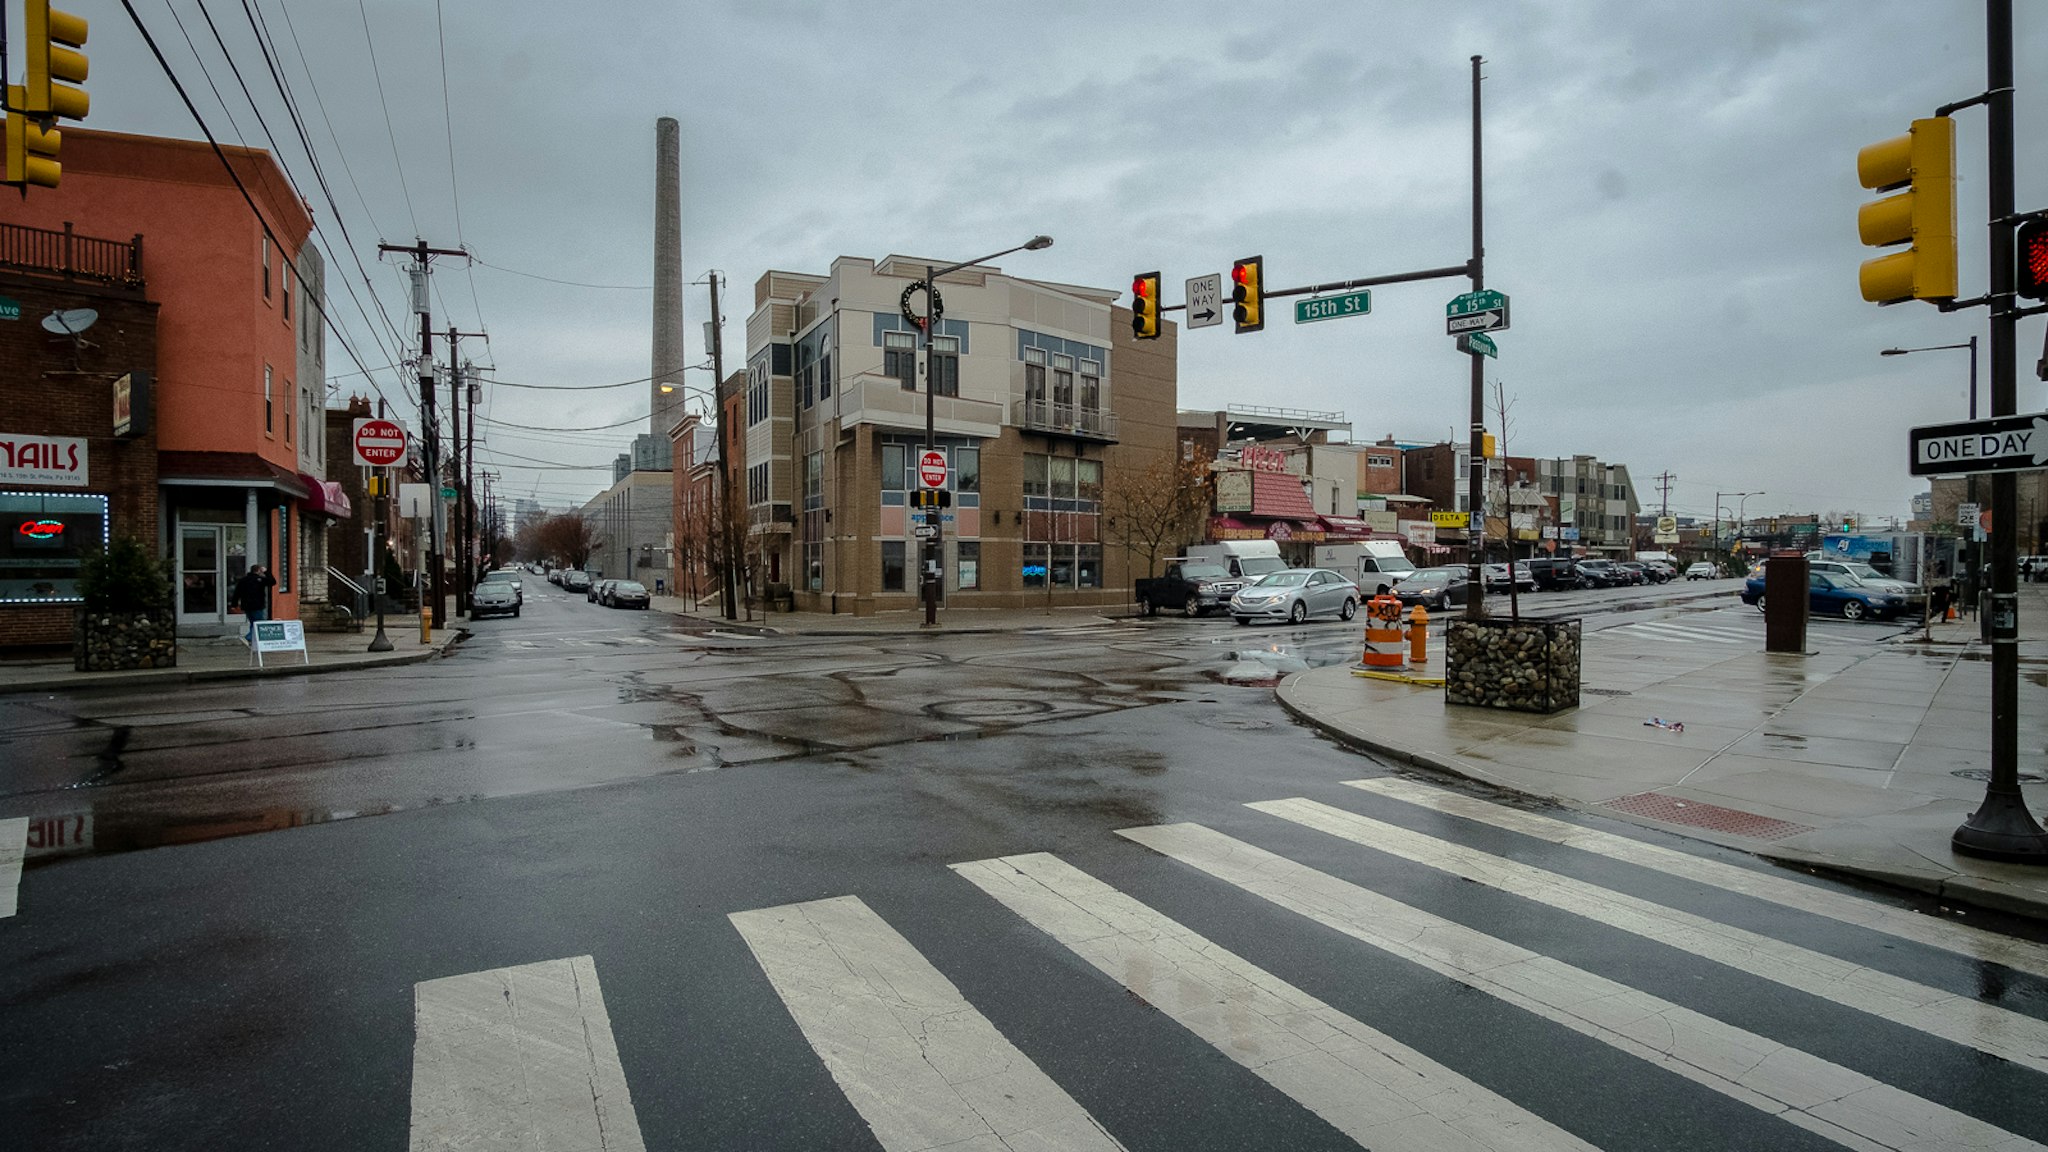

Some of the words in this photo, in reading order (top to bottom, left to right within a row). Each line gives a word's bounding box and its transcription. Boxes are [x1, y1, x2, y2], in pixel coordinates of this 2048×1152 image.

[1193, 280, 1214, 293] ONE
[1193, 293, 1215, 307] WAY
[1466, 298, 1486, 312] 15th
[1493, 298, 1502, 308] St
[1304, 299, 1337, 318] 15th
[1345, 296, 1361, 312] St
[1452, 319, 1467, 330] ONE
[1470, 317, 1485, 326] WAY
[362, 427, 376, 437] DO
[380, 428, 399, 438] NOT
[1927, 437, 1975, 460] ONE
[1981, 432, 2033, 457] DAY
[365, 448, 397, 458] ENTER
[1241, 444, 1285, 471] PIZZA
[924, 457, 932, 465] DO
[933, 458, 944, 466] NOT
[925, 473, 942, 481] ENTER
[1433, 514, 1460, 522] DELTA
